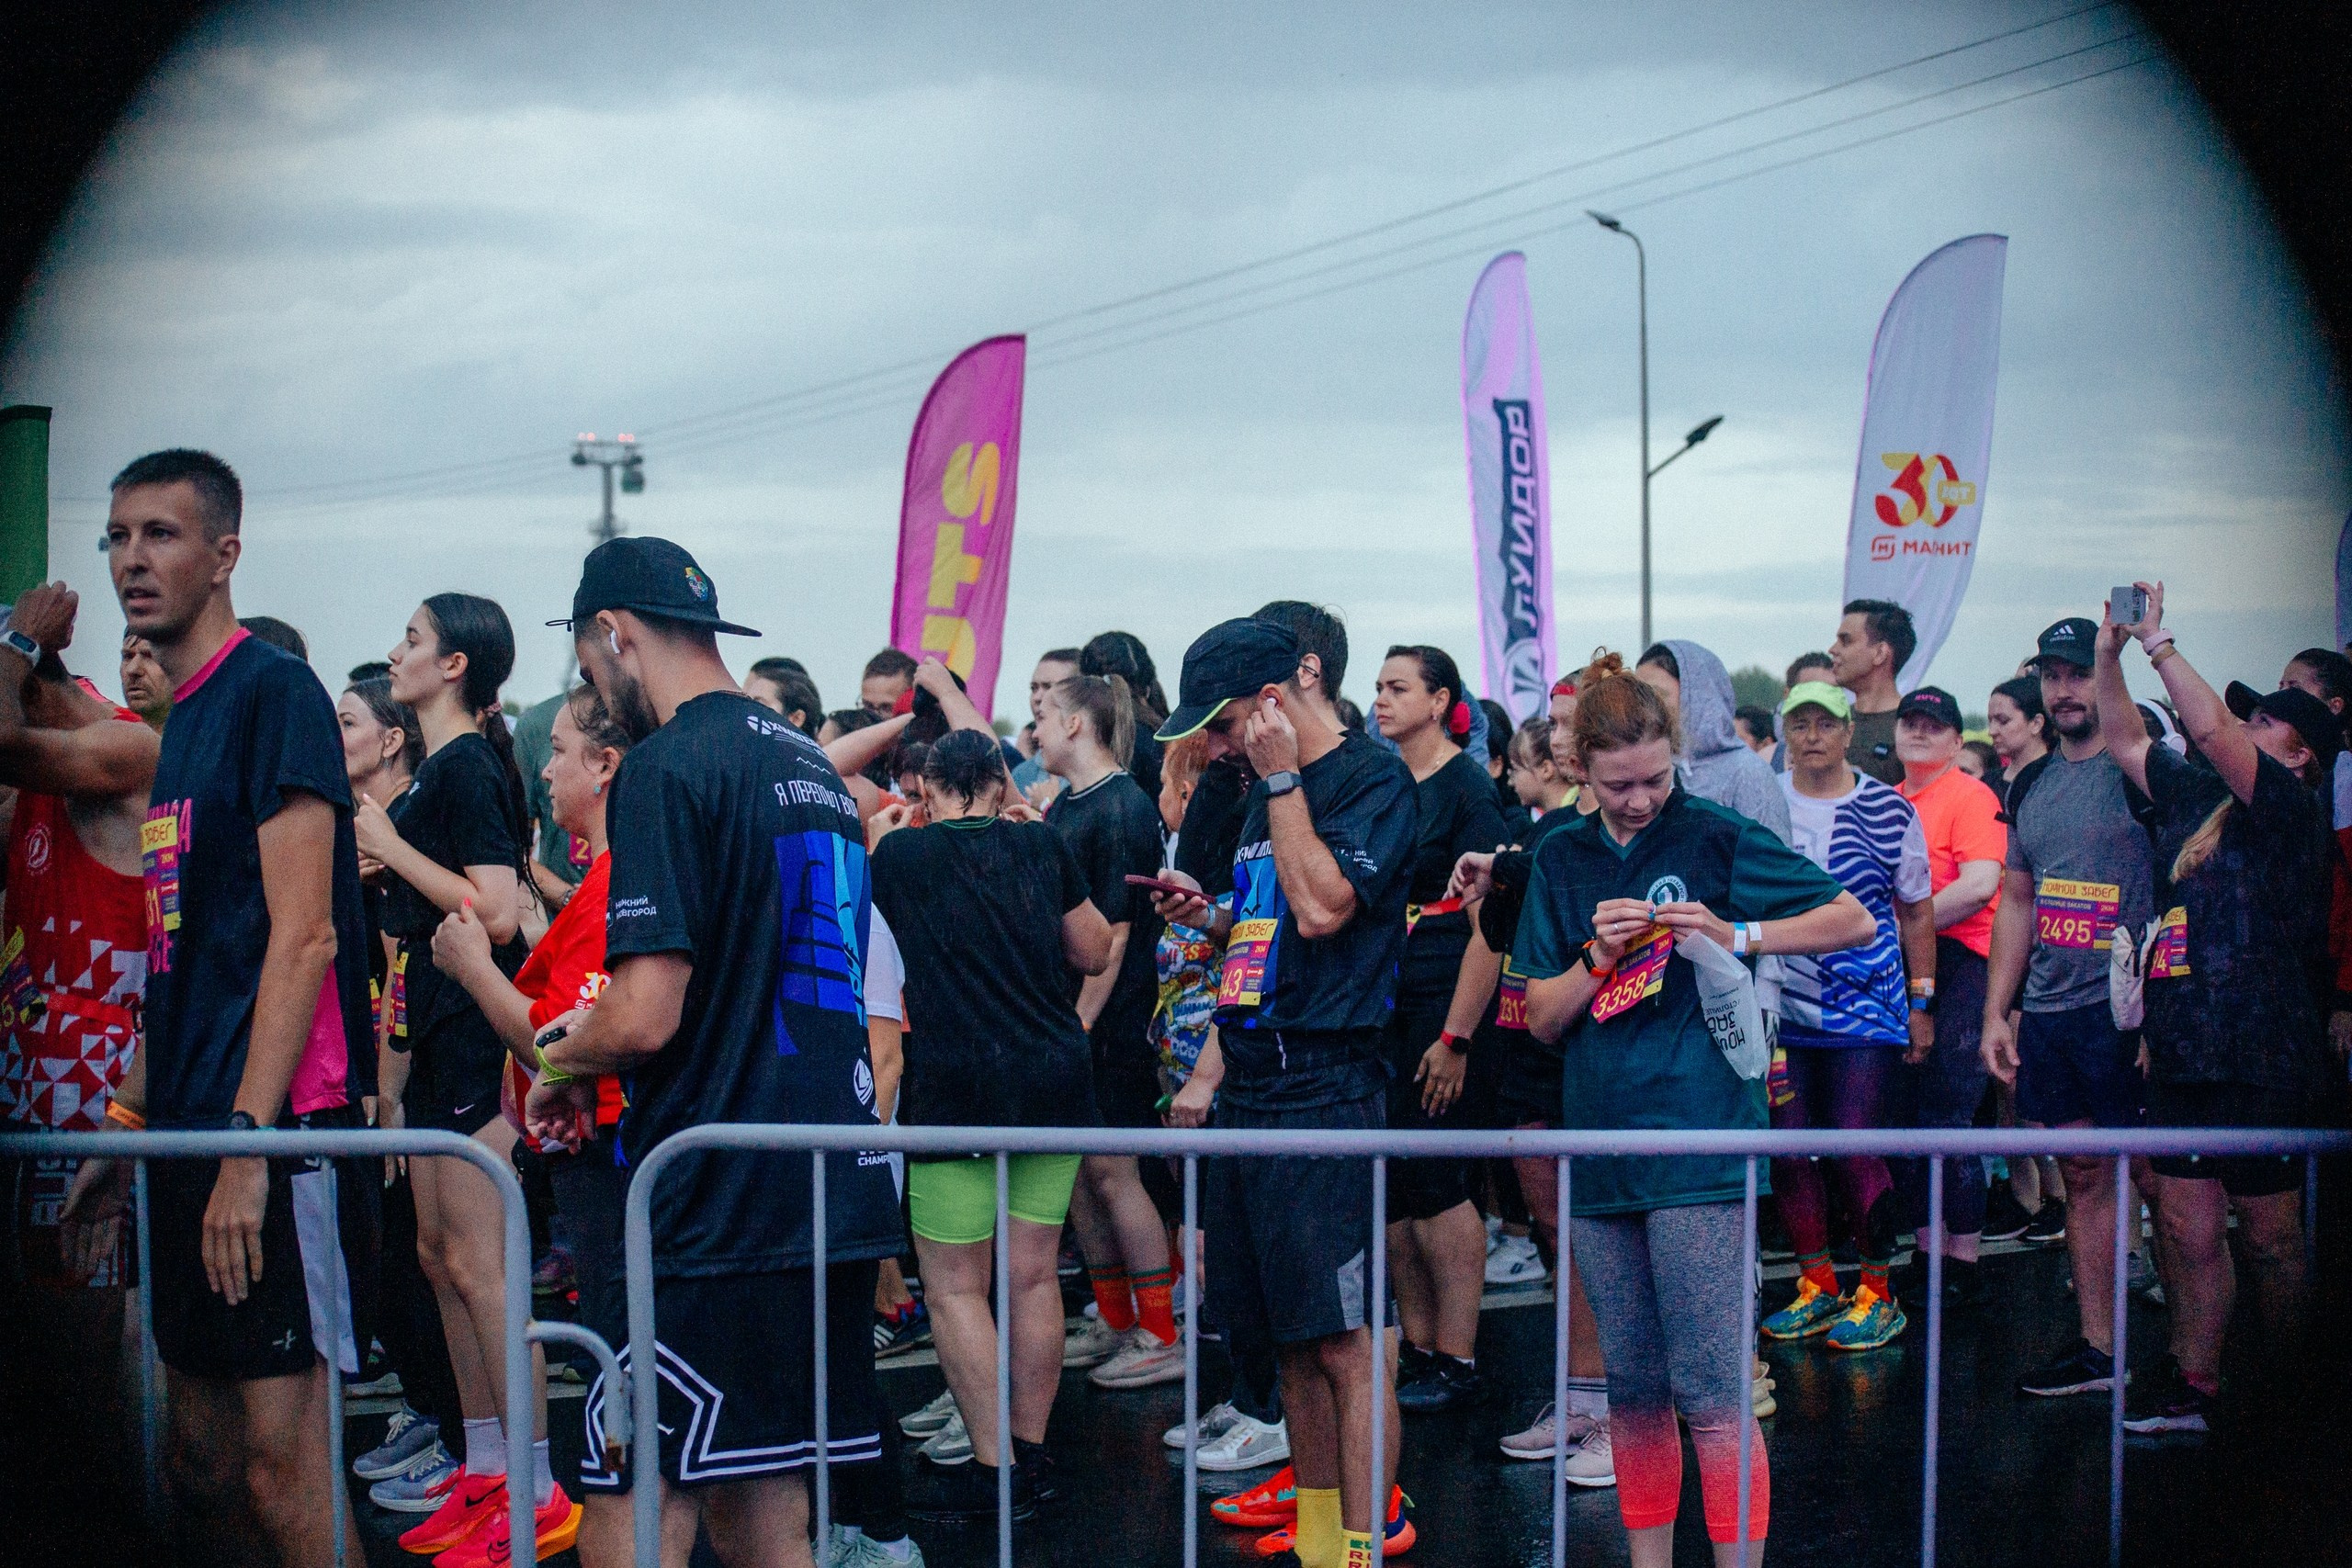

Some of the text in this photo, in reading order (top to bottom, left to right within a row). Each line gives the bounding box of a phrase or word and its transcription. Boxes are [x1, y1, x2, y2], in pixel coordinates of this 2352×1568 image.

[1875, 452, 1960, 528] 30
[922, 442, 1001, 683] UTS
[775, 783, 789, 807] Я
[2041, 916, 2091, 943] 2495
[1592, 971, 1647, 1019] 3358
[1706, 1010, 1736, 1034] ЗАБ
